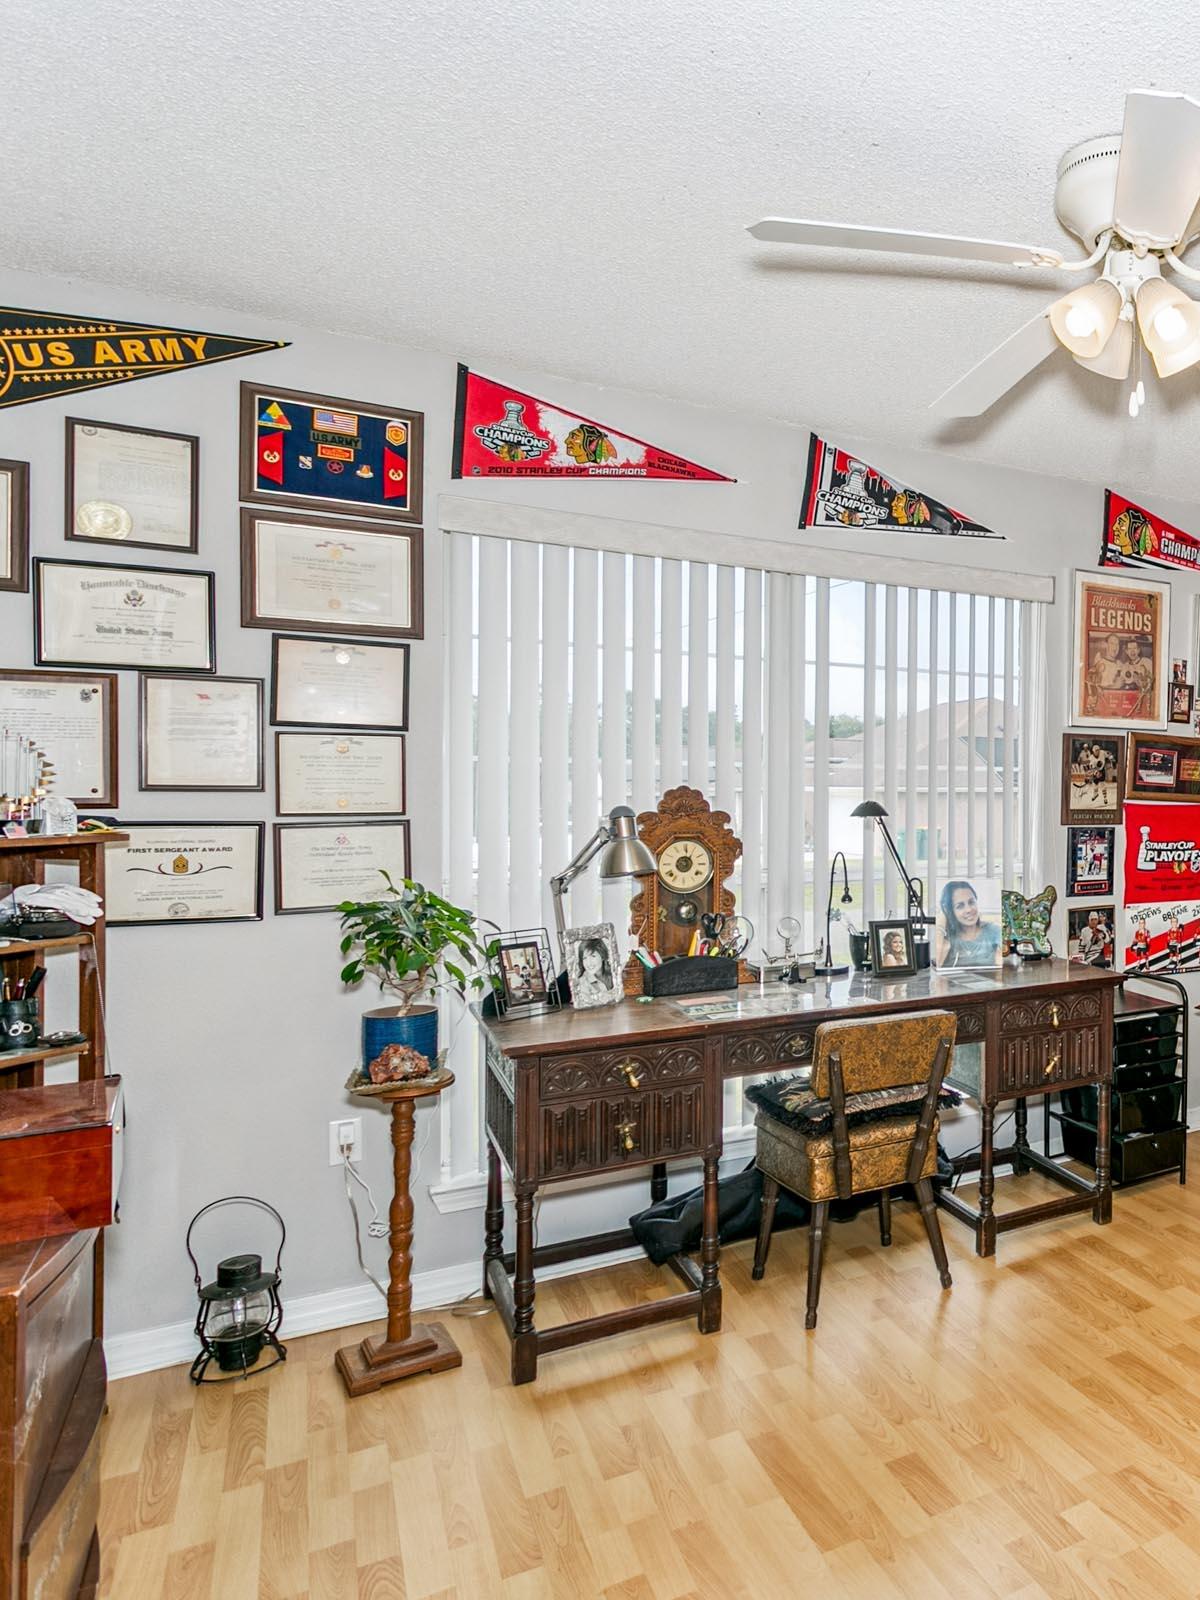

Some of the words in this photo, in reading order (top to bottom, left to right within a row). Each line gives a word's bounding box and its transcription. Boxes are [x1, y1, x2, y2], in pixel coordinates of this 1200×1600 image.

[12, 340, 75, 368] US
[94, 336, 208, 364] ARMY
[475, 427, 549, 449] CHAMPIONS
[565, 466, 587, 474] CUP
[817, 492, 887, 518] CHAMPIONS
[1091, 595, 1136, 610] Blackhawks
[1091, 608, 1152, 632] LEGENDS
[1178, 841, 1195, 849] CUP
[1130, 915, 1138, 924] 19
[1139, 907, 1162, 919] TOEWS
[1162, 912, 1172, 922] 88
[1172, 906, 1189, 916] KANE
[1192, 909, 1197, 917] 2
